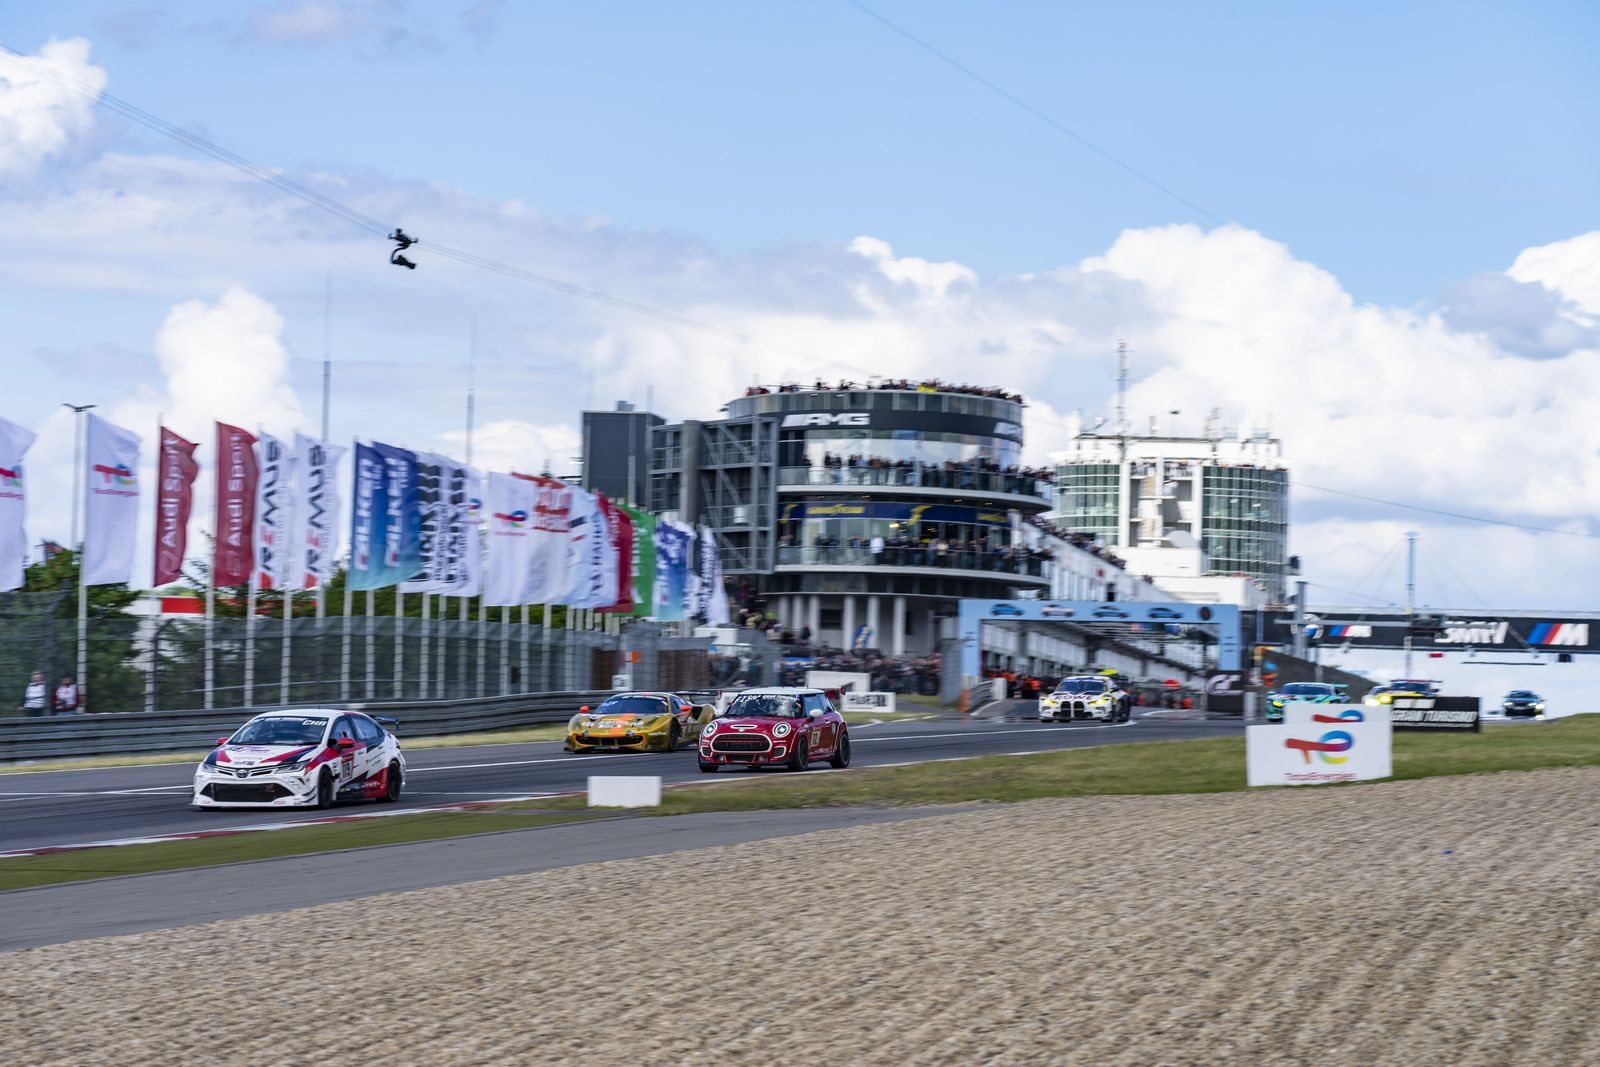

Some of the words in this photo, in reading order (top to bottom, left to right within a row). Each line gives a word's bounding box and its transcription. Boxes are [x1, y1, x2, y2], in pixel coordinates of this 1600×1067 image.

[800, 413, 870, 427] AMG
[161, 498, 178, 548] Audi
[227, 499, 242, 546] Audi
[261, 440, 281, 571] REMUS
[306, 445, 327, 572] REMUS
